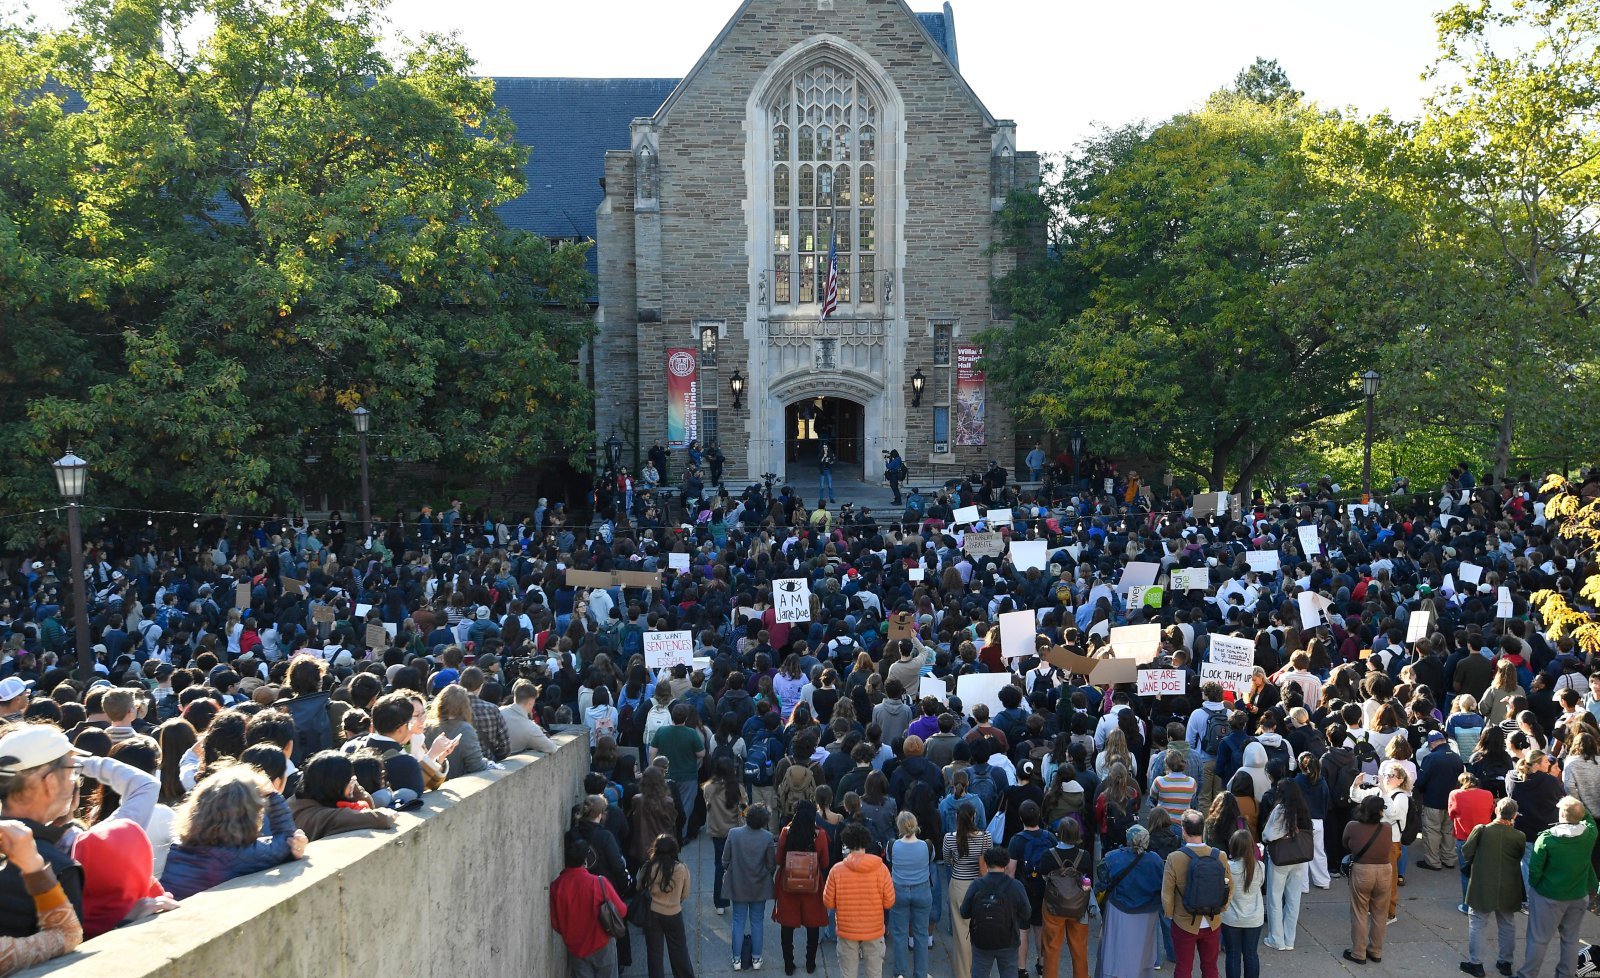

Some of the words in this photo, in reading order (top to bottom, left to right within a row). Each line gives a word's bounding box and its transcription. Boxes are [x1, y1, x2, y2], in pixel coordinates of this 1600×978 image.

[777, 608, 795, 622] Jane
[796, 607, 810, 620] Doe
[664, 632, 683, 640] WANT
[646, 640, 692, 651] SENTENCES
[1146, 670, 1158, 680] WE
[1160, 670, 1177, 679] ARE
[1202, 669, 1222, 679] LOCK
[1224, 670, 1242, 681] THEM
[1244, 674, 1252, 682] UP
[1140, 681, 1158, 693] JANE
[1162, 680, 1181, 691] DOE
[1217, 680, 1236, 690] NOW
